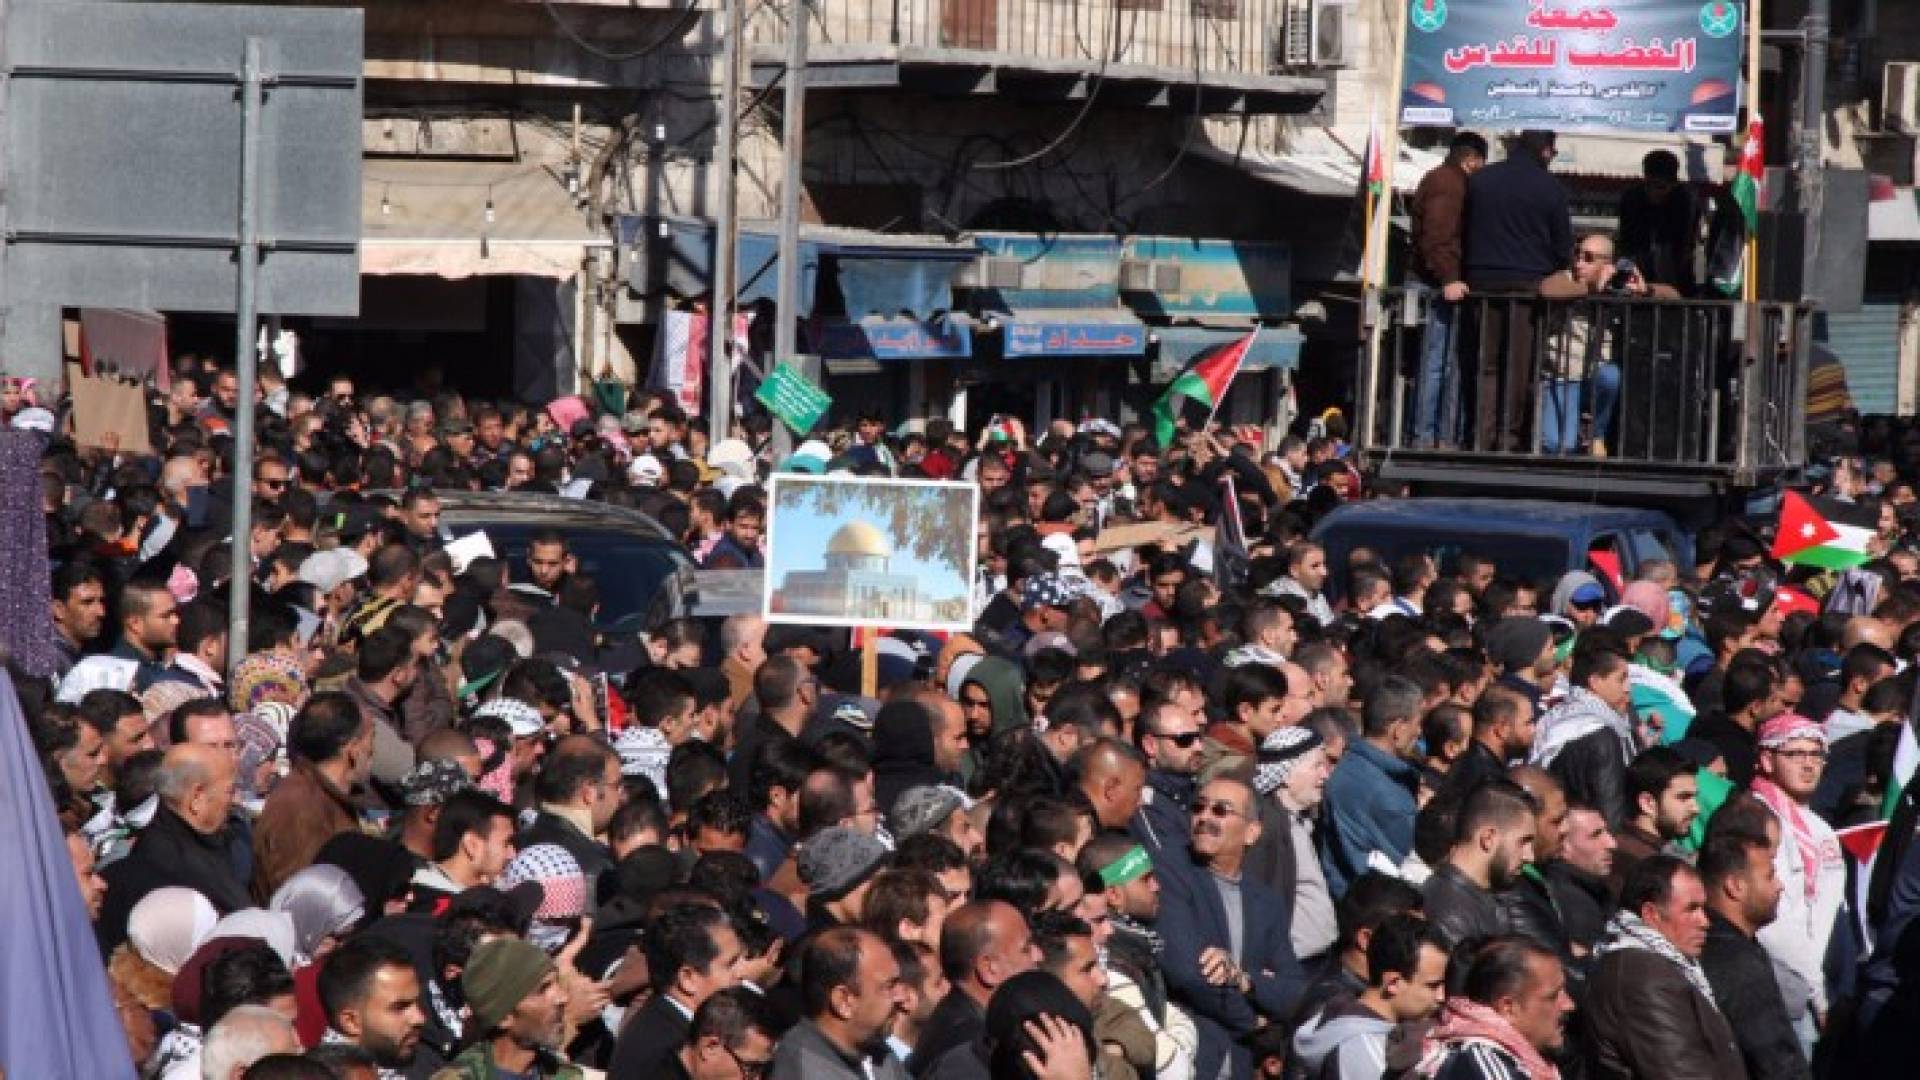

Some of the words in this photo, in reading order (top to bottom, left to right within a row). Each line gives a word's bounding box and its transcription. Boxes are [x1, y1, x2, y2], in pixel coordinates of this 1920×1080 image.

[1525, 0, 1619, 36] جمعة
[1445, 34, 1558, 73] للقدس
[1567, 37, 1696, 73] الغضب
